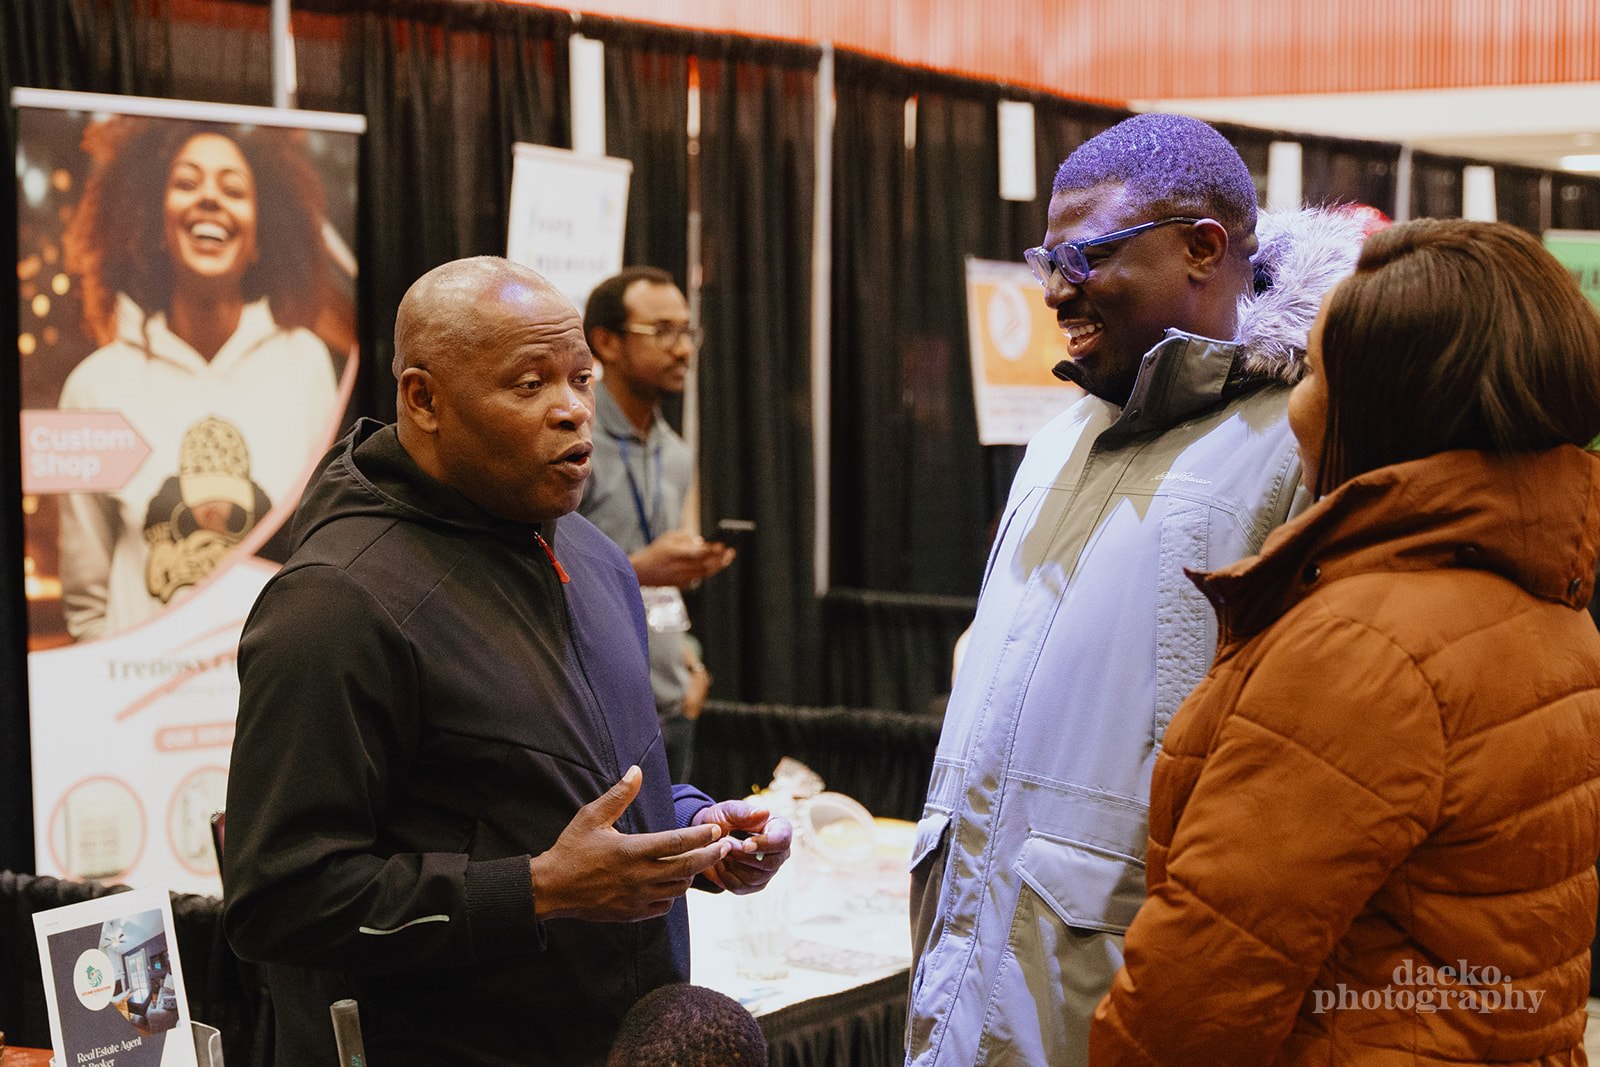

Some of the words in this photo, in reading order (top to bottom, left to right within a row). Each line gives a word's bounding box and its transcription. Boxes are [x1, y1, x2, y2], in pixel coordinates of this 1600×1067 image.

[31, 426, 135, 450] Custom
[32, 452, 100, 482] Shop
[77, 1050, 94, 1063] Real
[95, 1045, 119, 1058] Estate
[121, 1037, 142, 1051] Agent
